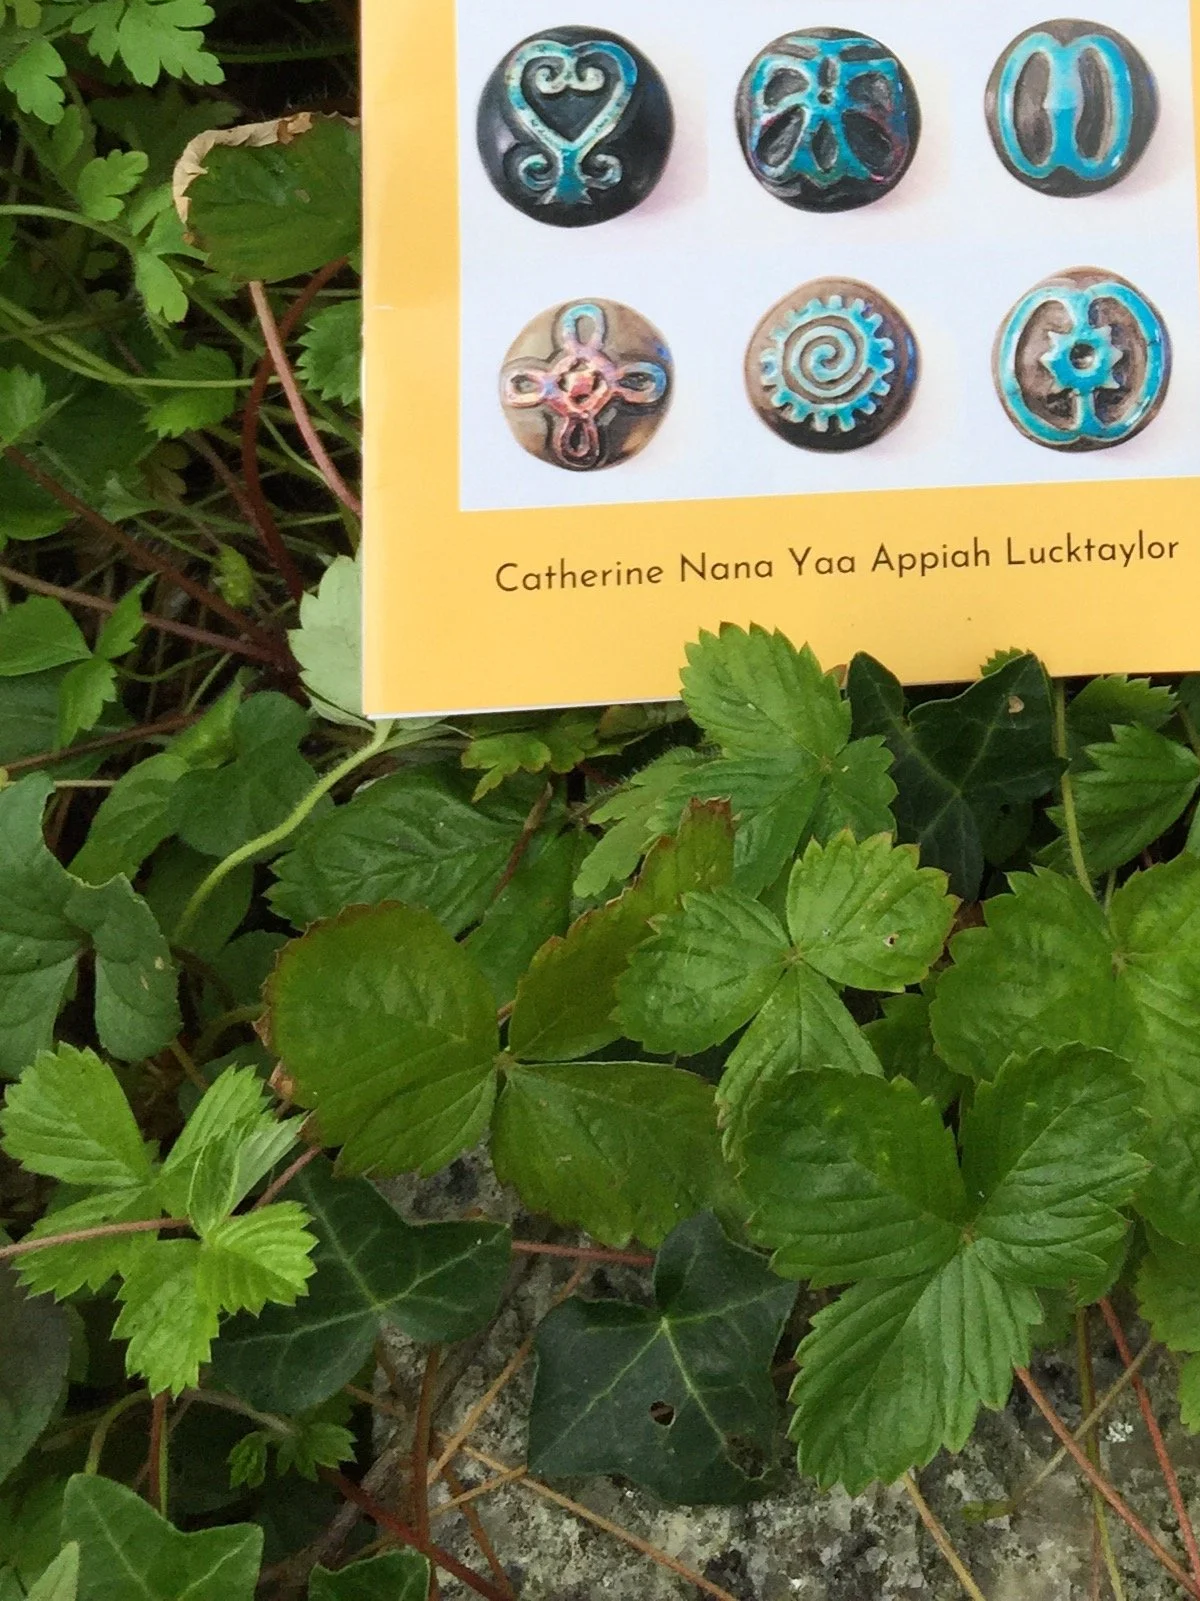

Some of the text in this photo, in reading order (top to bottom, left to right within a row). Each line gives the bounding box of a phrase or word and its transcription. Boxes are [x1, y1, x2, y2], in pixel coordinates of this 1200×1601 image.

[495, 529, 1179, 592] Catherine Nana Yaa Appiah Lucktaylor
